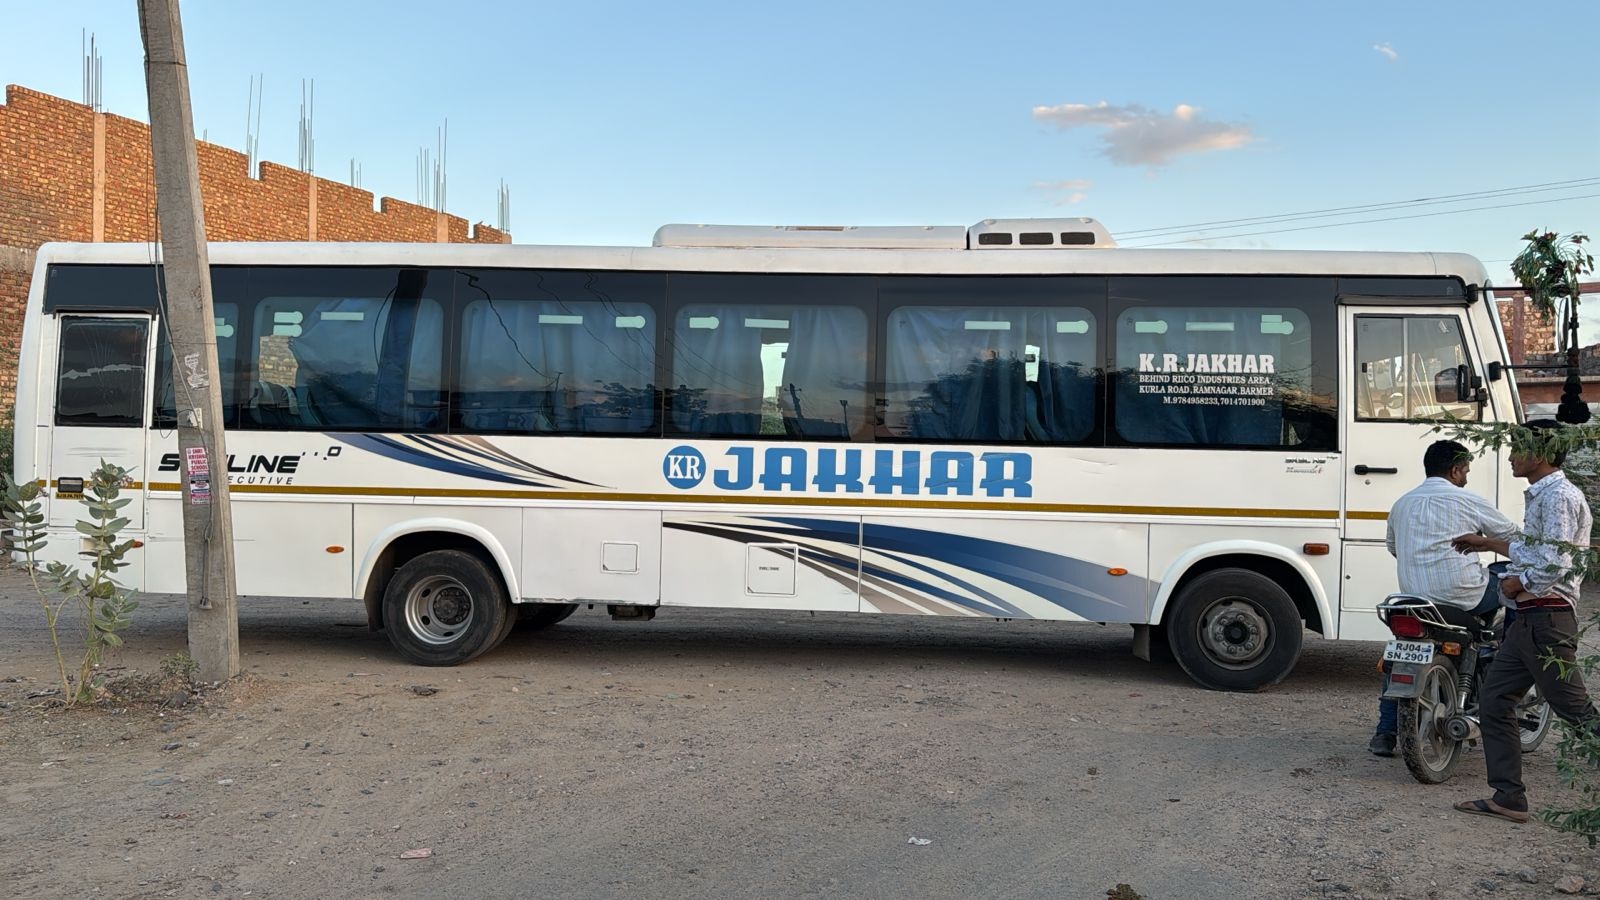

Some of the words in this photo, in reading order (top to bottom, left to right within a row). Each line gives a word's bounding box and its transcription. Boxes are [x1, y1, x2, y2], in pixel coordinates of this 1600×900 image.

[1139, 353, 1275, 373] K.R.JAKHAR
[1139, 374, 1170, 383] BEHIND
[1197, 375, 1246, 384] INDUSTRIES
[1139, 385, 1166, 394] KURLA
[158, 453, 301, 474] SLINE
[667, 454, 702, 481] KR
[713, 446, 1033, 499] JAKHAR
[1395, 643, 1421, 652] RJ04
[1387, 651, 1429, 662] SN.2901
